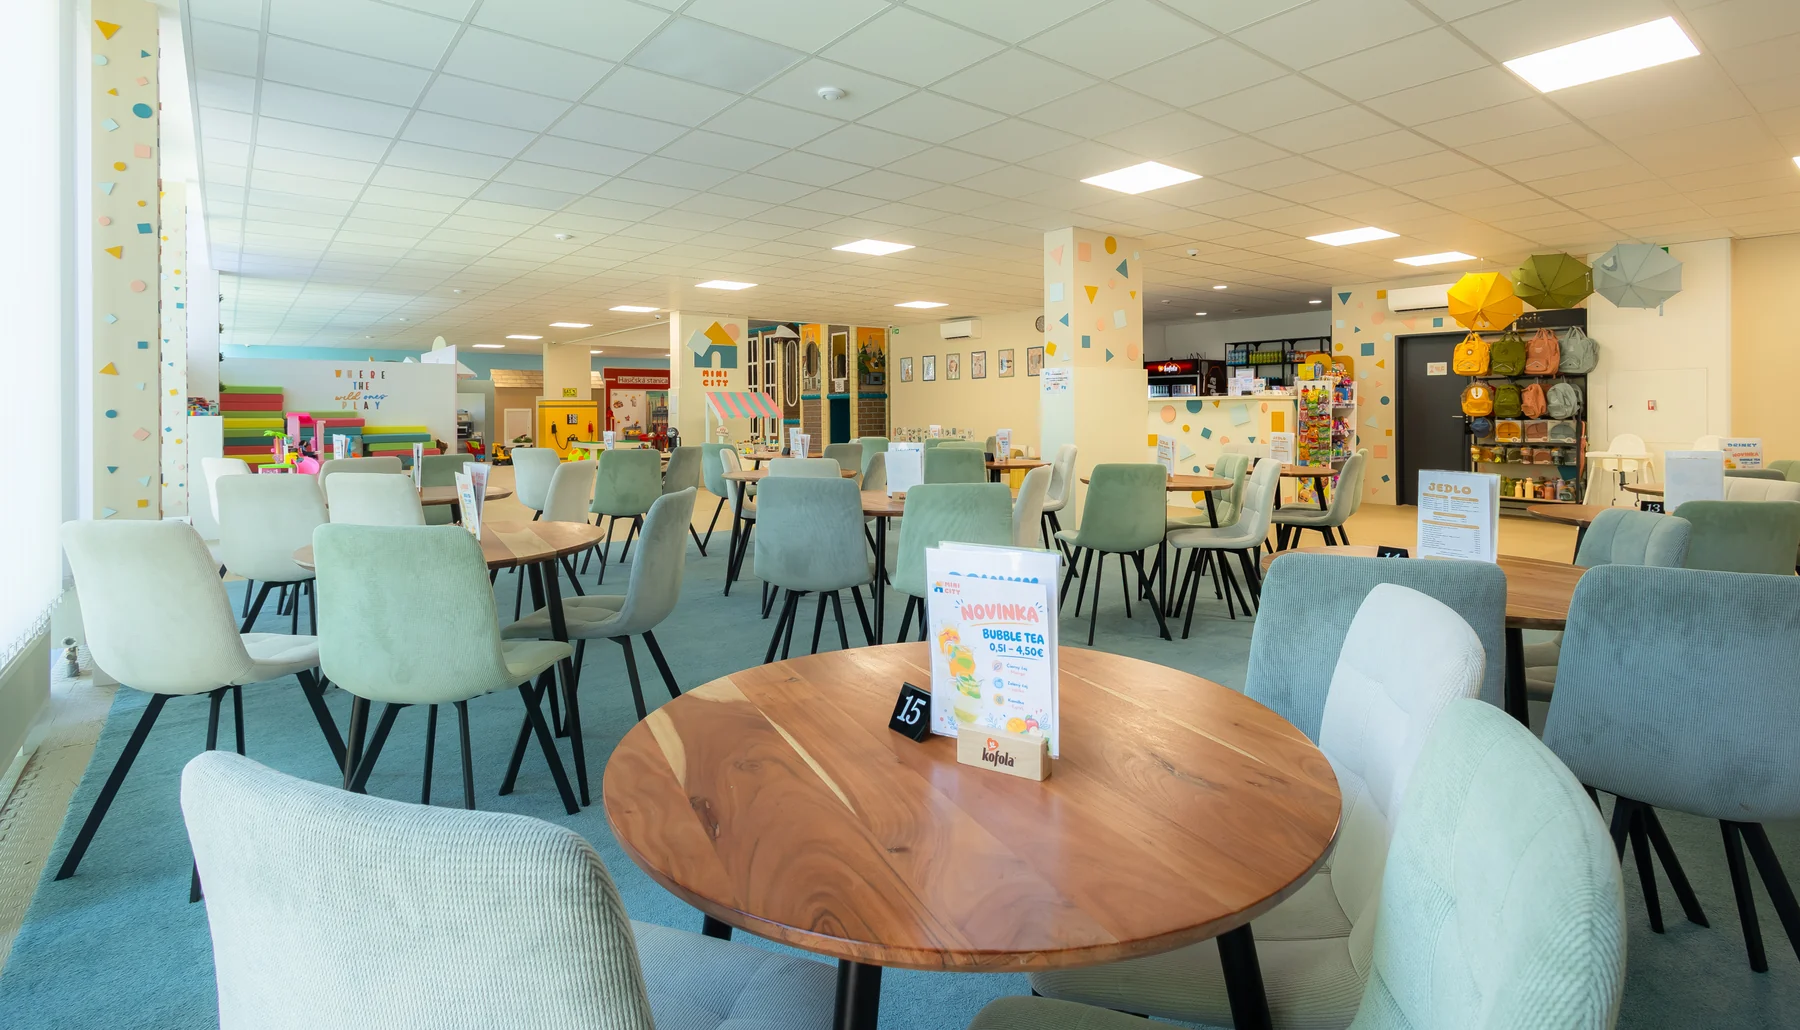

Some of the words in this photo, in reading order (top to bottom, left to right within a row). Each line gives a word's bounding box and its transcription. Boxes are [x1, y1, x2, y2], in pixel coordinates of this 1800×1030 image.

[335, 369, 385, 379] WHERE
[618, 376, 646, 384] Hasičská
[702, 379, 729, 387] CITY
[353, 382, 370, 390] THE
[1207, 377, 1217, 396] ola
[335, 391, 361, 401] wild
[342, 401, 380, 410] PLAY
[1428, 482, 1471, 495] JEDLO
[1646, 503, 1661, 513] 13
[961, 603, 1039, 623] NOVINKA
[982, 628, 1022, 643] BUBBLE
[1024, 632, 1045, 645] TEA
[1016, 645, 1044, 657] 4,50€
[896, 695, 927, 725] 15
[981, 747, 1014, 767] kofola
